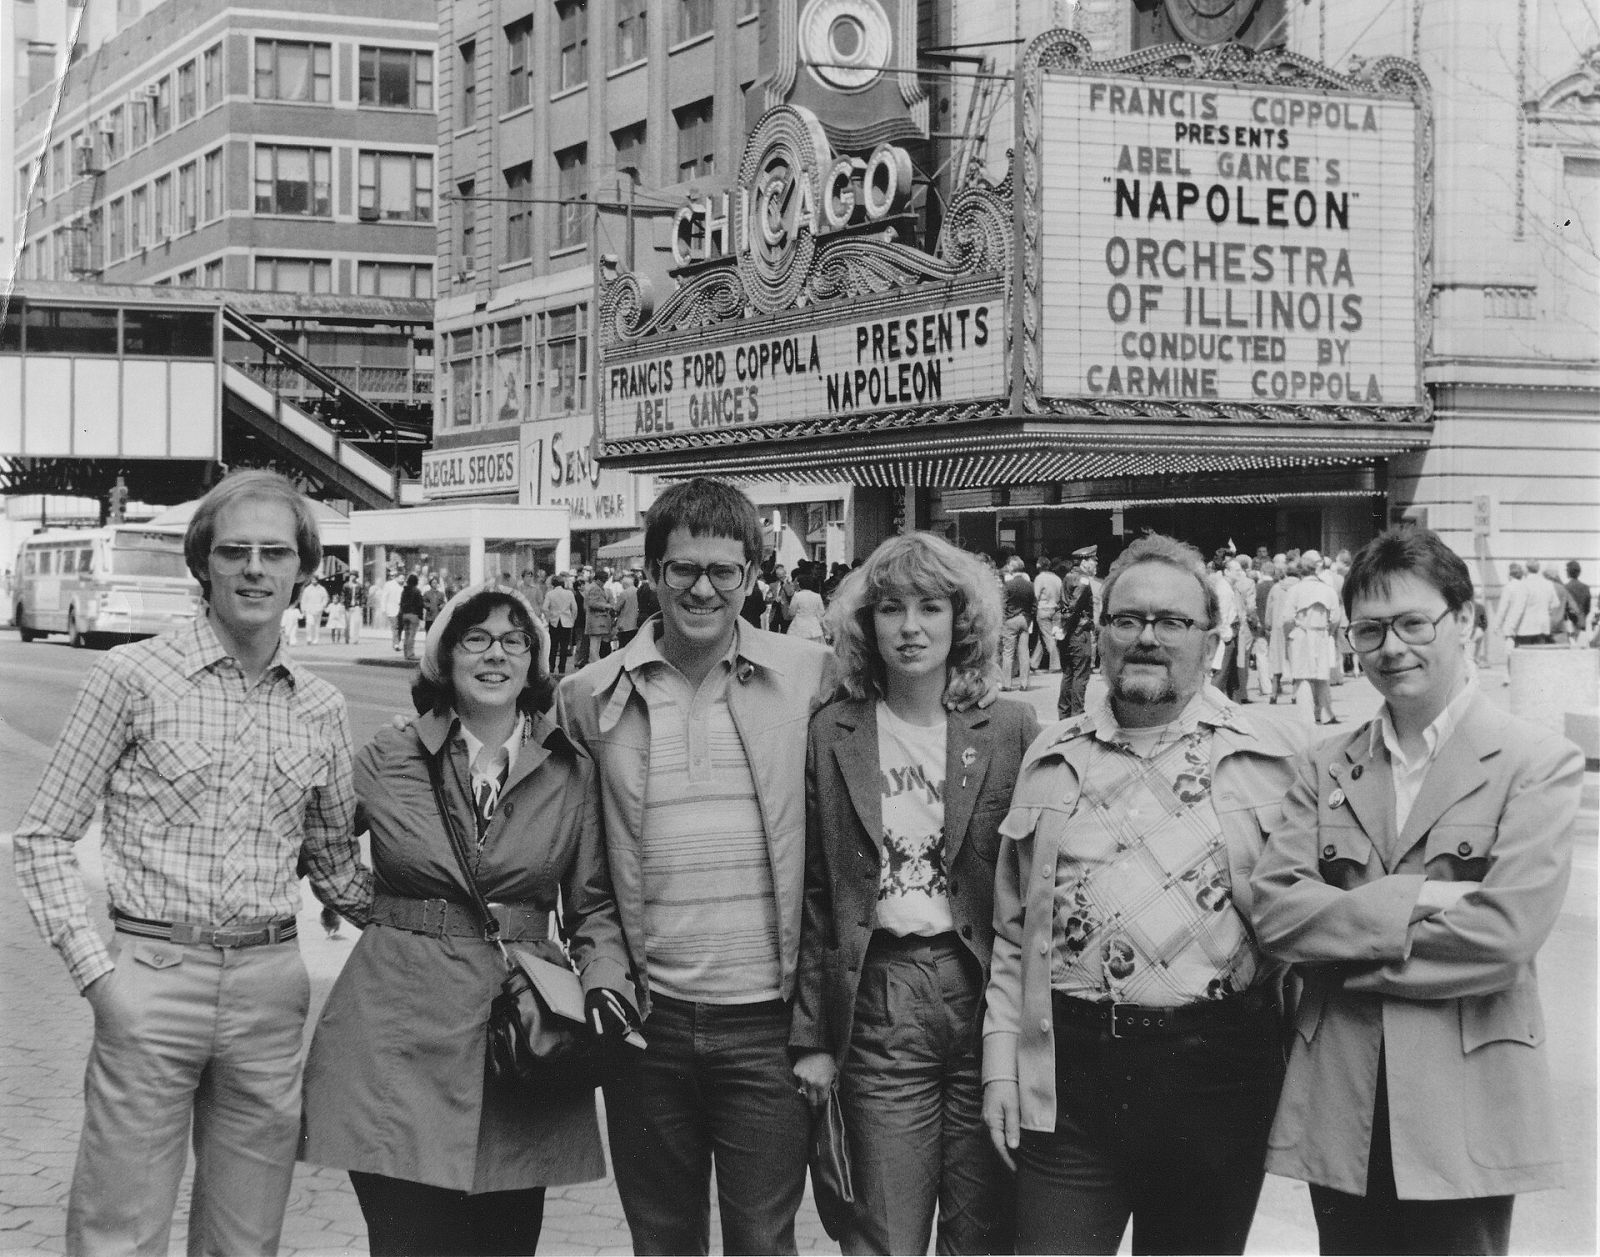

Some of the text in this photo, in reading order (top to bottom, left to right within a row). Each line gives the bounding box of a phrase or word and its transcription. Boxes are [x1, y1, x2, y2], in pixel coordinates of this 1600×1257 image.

[1088, 84, 1377, 132] FRANCIS COPPOLA
[1175, 122, 1289, 149] PRESENTS
[1117, 146, 1341, 186] ABEL GANCE'S
[671, 142, 906, 269] CHICAGO
[1105, 236, 1354, 287] ORCHESTRA
[1107, 283, 1363, 333] OF ILLINOIS
[610, 306, 989, 401] FRANCIS FORD COPPOLA PRESENTS
[1121, 331, 1351, 366] CONDUCTED BY
[1086, 364, 1383, 402] CARMINE COPPOLA
[634, 384, 760, 435] ABEL GANCE'S
[423, 451, 514, 489] REGAL SHOES
